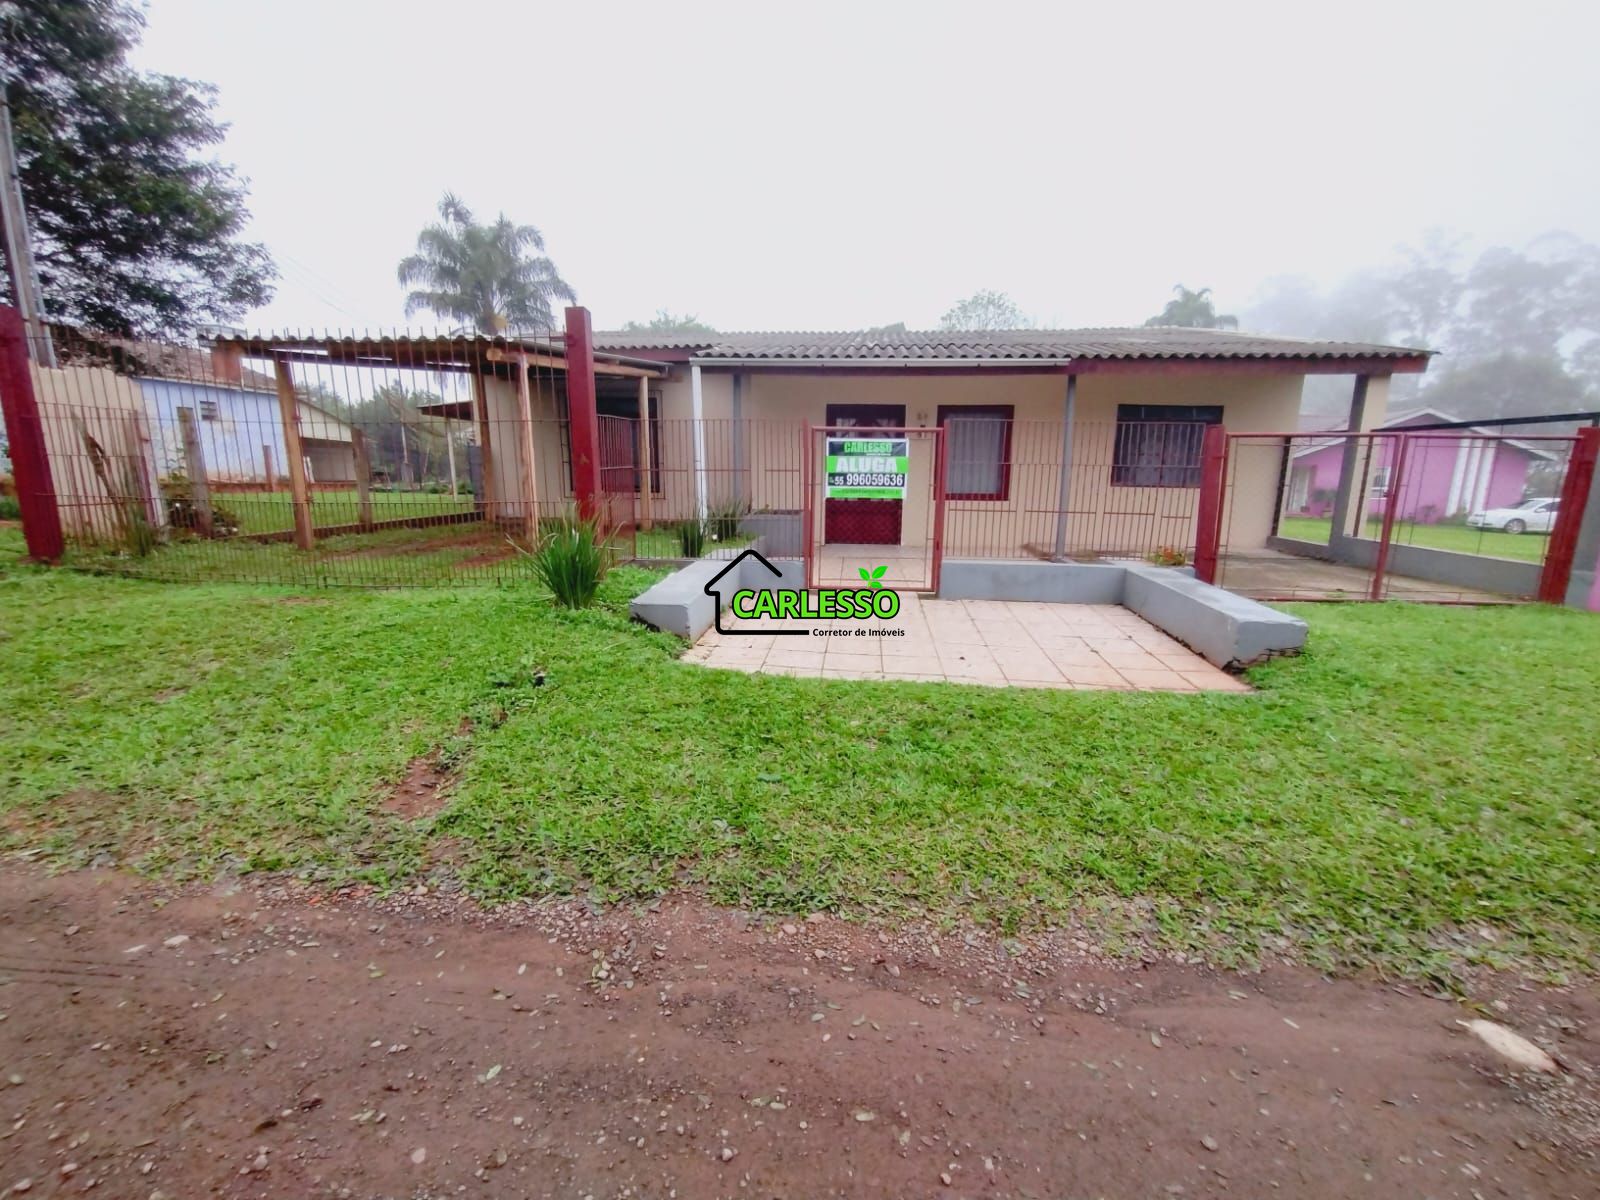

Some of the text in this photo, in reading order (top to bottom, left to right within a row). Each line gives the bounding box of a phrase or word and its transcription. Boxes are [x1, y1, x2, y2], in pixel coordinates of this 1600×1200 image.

[844, 442, 893, 453] CARLESSO
[836, 456, 898, 472] ALUGA
[846, 473, 903, 485] 996059636
